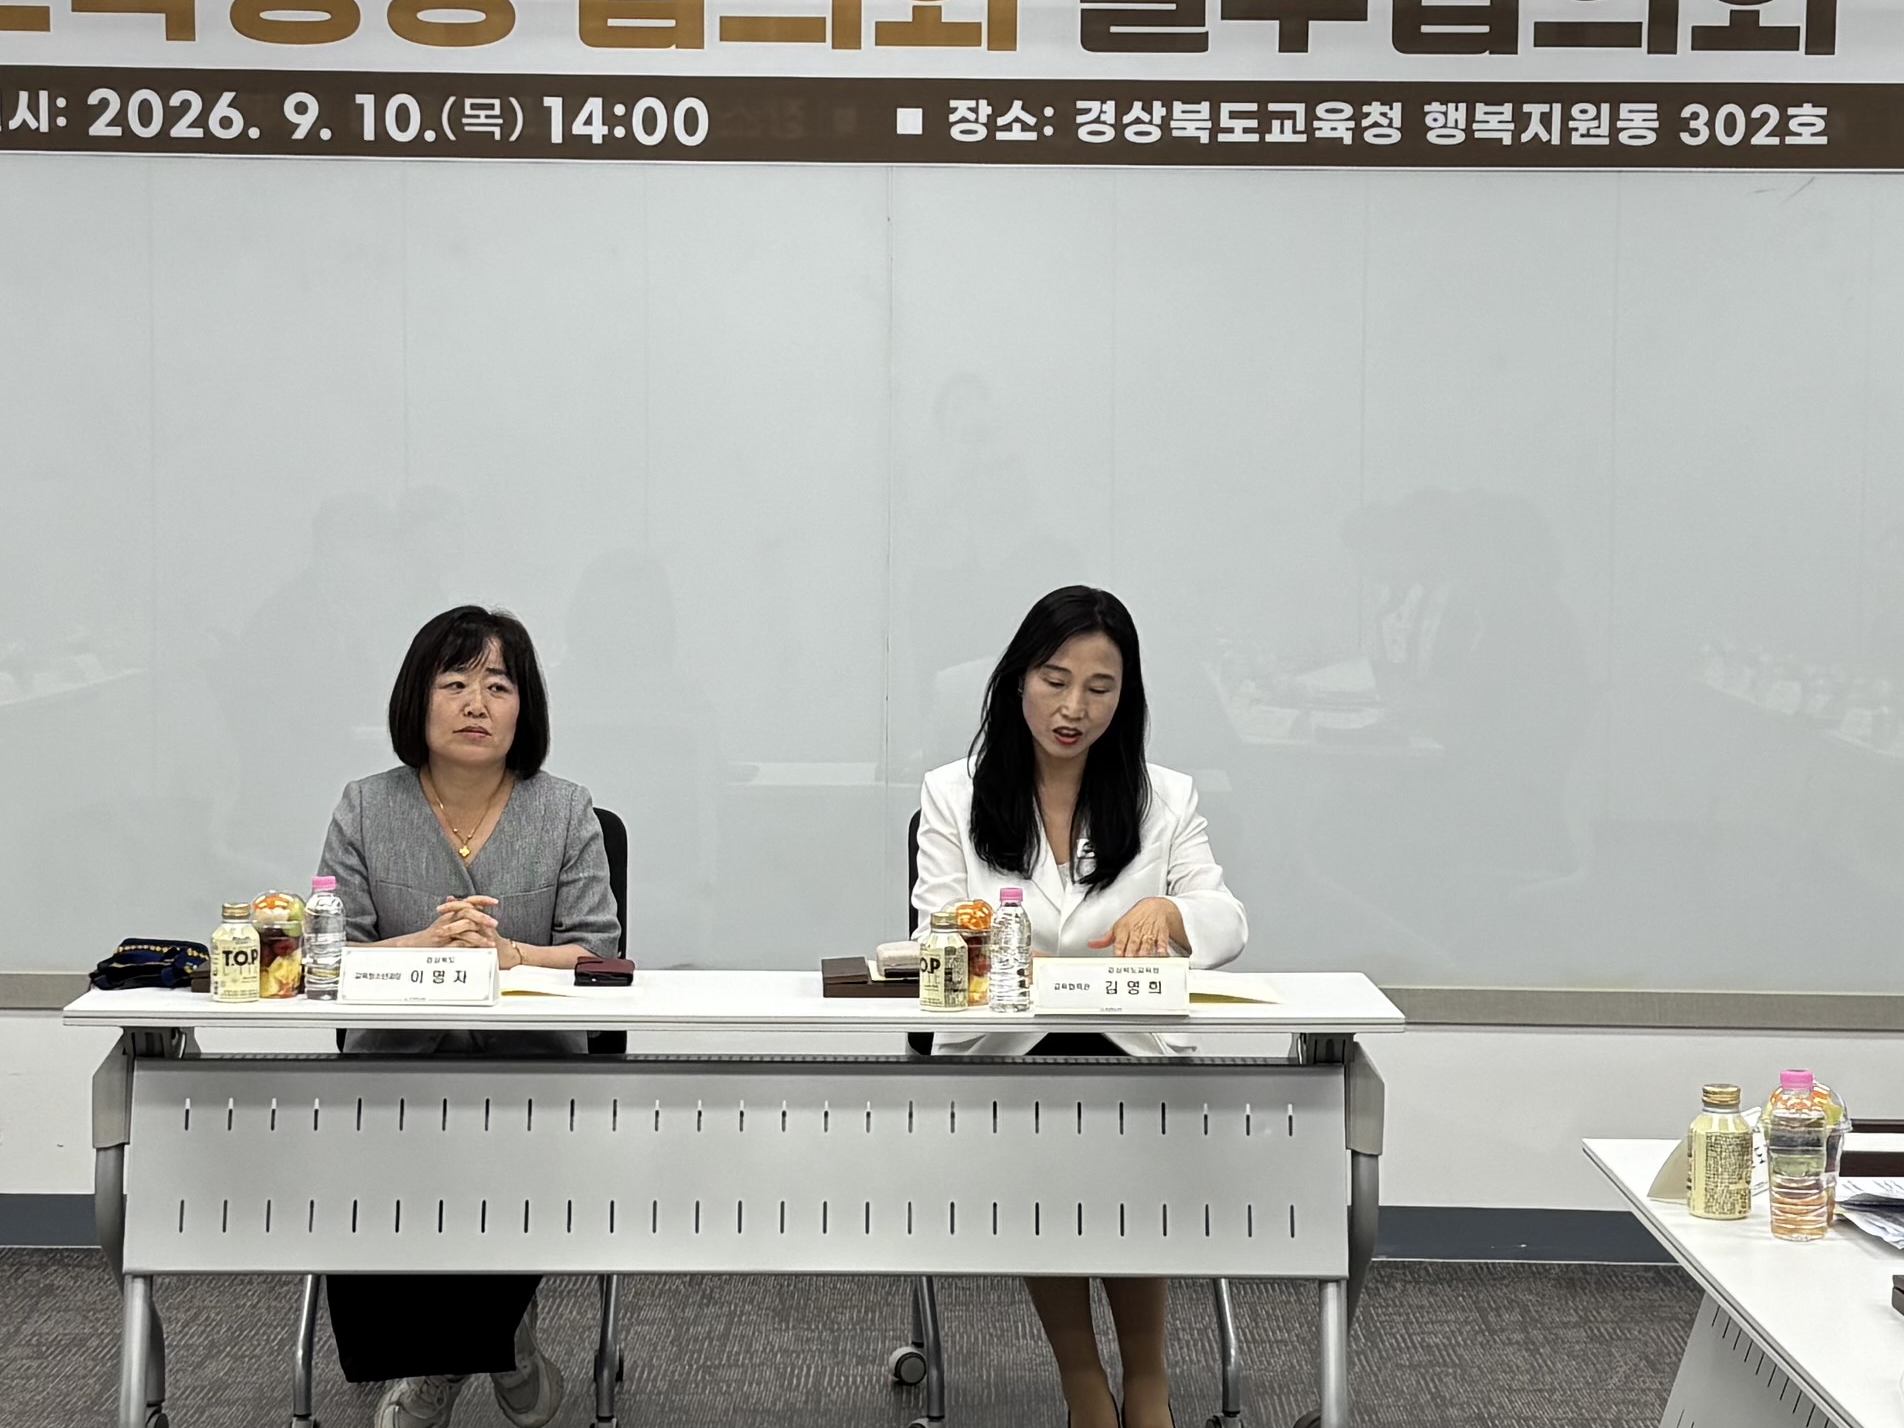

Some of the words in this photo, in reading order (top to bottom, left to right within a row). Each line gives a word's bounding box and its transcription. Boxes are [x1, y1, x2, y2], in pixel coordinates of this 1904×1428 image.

[87, 88, 261, 141] 2026.
[284, 92, 332, 142] 9.
[354, 92, 524, 145] 10.(목)
[542, 96, 709, 147] 14:00
[948, 99, 1055, 143] 장소:
[1074, 100, 1402, 146] 경상북도교육청
[1423, 101, 1661, 148] 행복지원동
[1679, 102, 1829, 149] 302호
[222, 949, 259, 967] T.O.P
